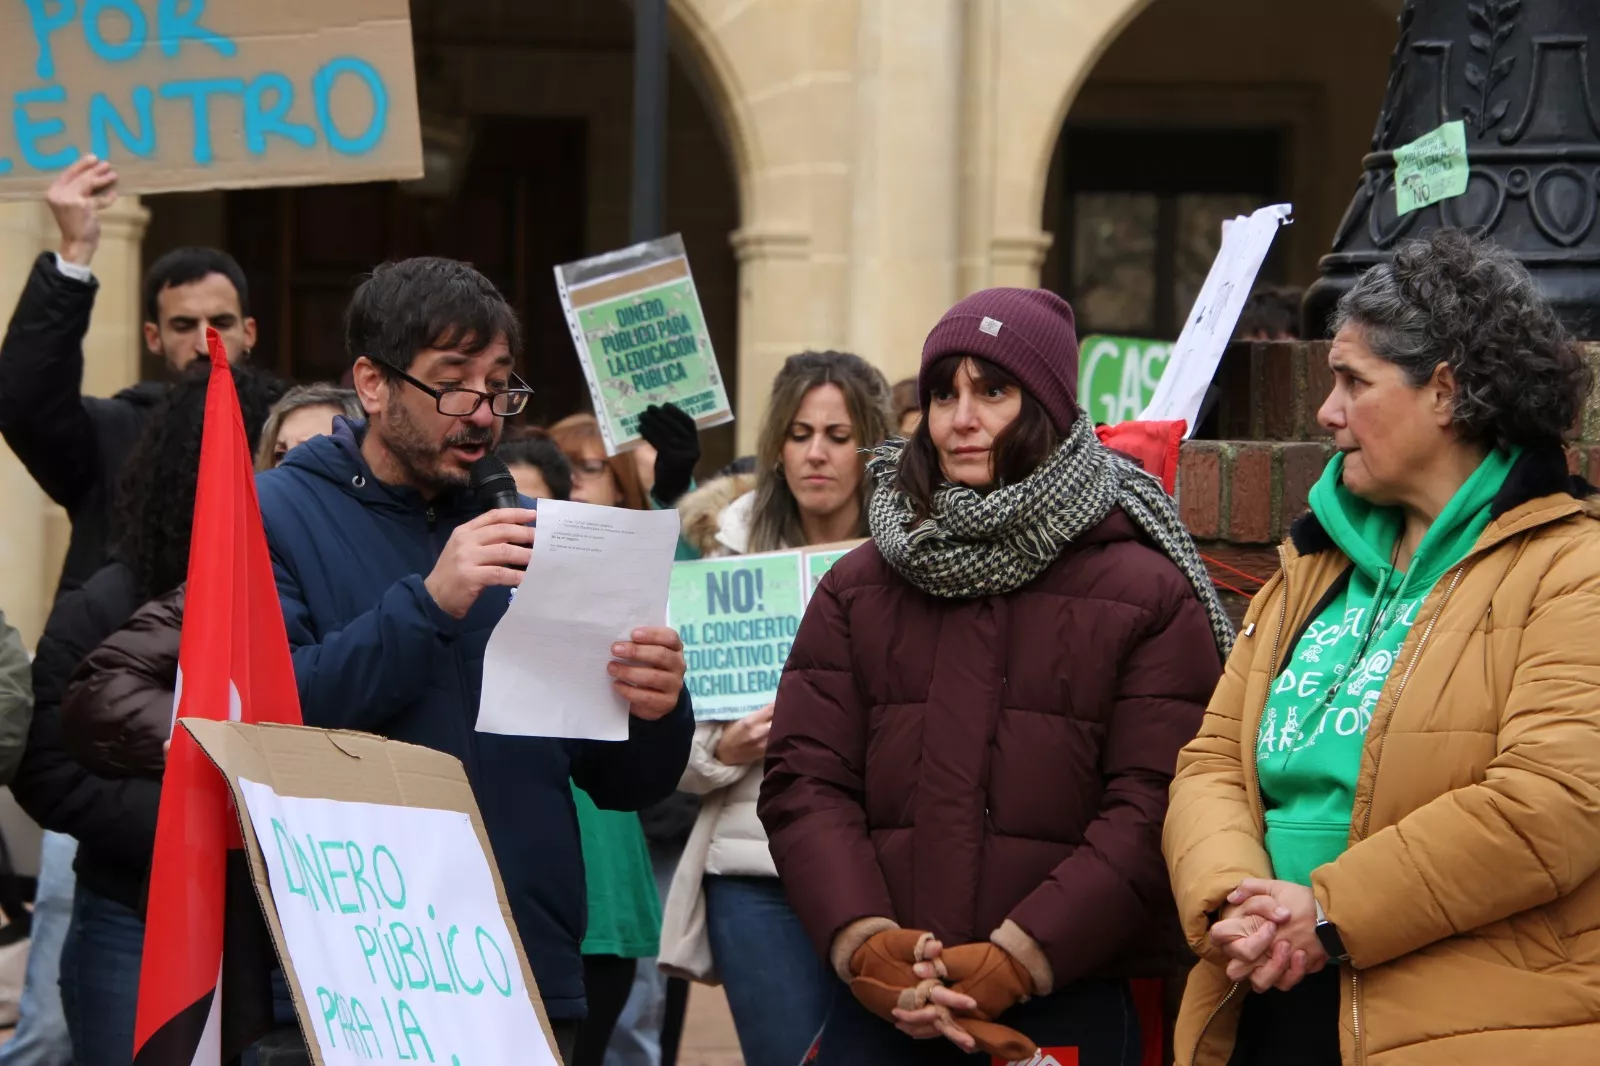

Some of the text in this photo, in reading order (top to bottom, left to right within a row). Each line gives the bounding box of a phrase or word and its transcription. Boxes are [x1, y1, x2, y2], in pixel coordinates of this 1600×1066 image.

[26, 0, 237, 79] POR
[0, 55, 388, 172] ENTRO
[614, 298, 666, 328] DINERO
[658, 313, 693, 338] PARA
[606, 355, 627, 377] LA
[706, 567, 765, 616] NO!
[679, 614, 798, 645] AL CONCIERTO
[687, 669, 782, 697] ACHILLERA
[316, 986, 436, 1064] PARA LA
